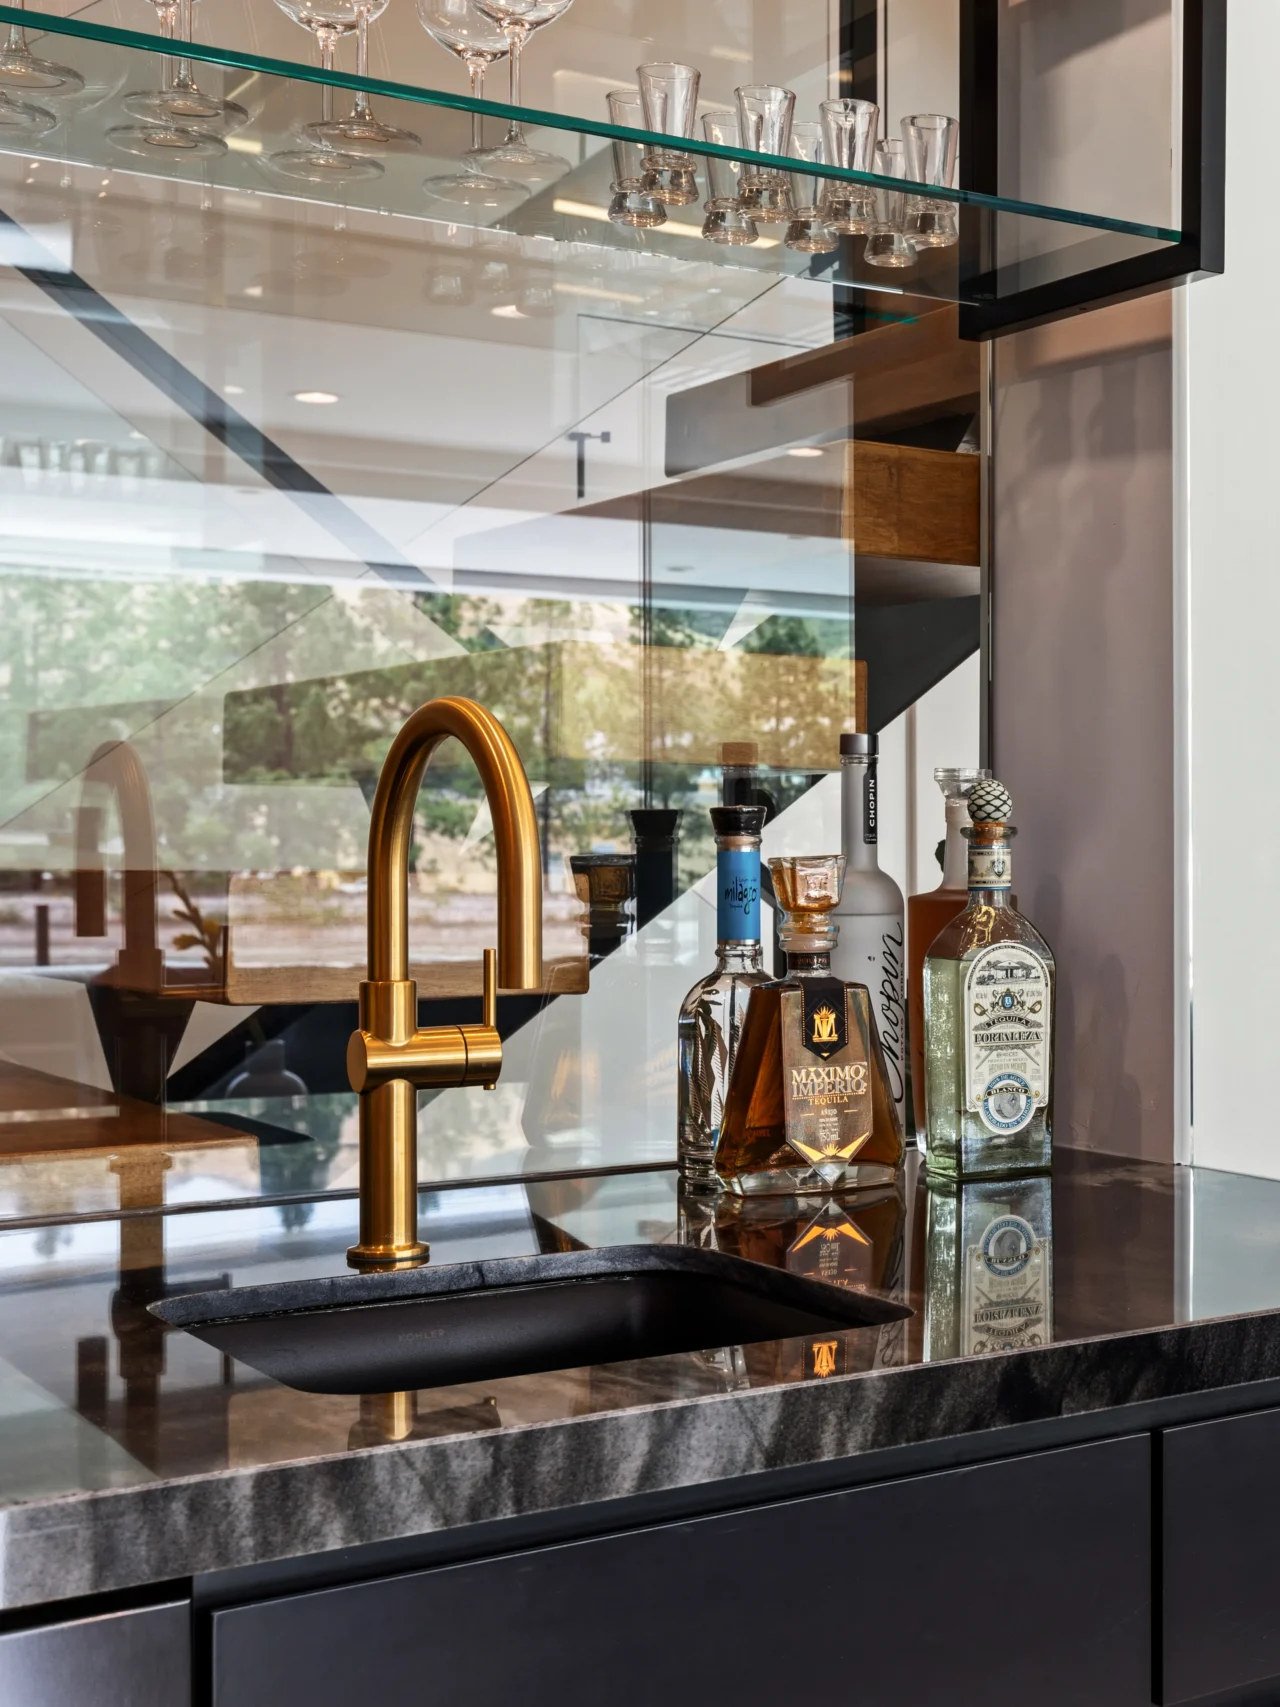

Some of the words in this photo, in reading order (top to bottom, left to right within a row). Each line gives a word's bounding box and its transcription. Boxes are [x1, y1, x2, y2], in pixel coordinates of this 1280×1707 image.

[724, 876, 757, 915] milagro
[990, 1016, 1026, 1026] TEQUILA
[974, 1031, 1041, 1044] FORTALEZA
[808, 1096, 848, 1106] TEQUILA
[398, 1329, 445, 1342] KOHLER
